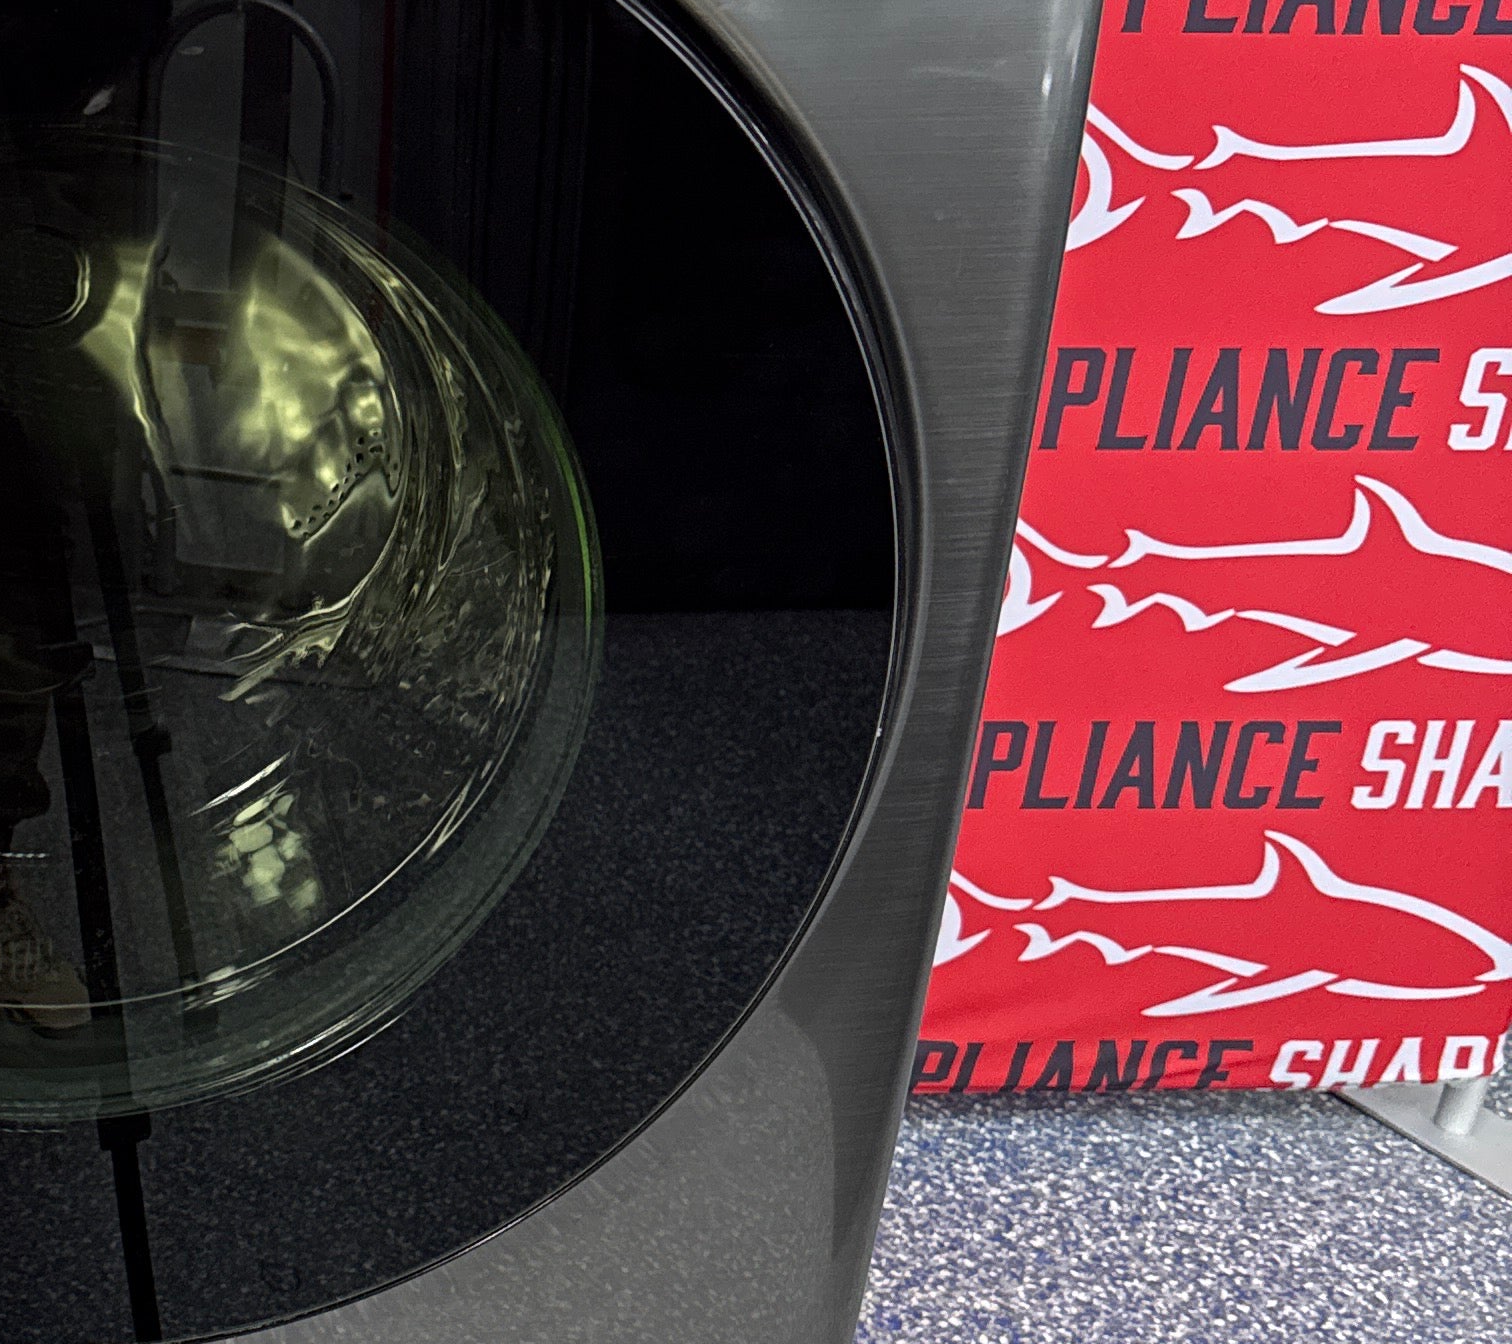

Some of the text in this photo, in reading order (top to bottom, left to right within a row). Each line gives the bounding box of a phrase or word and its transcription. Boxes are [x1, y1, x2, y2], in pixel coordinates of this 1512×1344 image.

[1038, 348, 1440, 452] PLIANCE
[967, 719, 1512, 810] PLIANCE SHA
